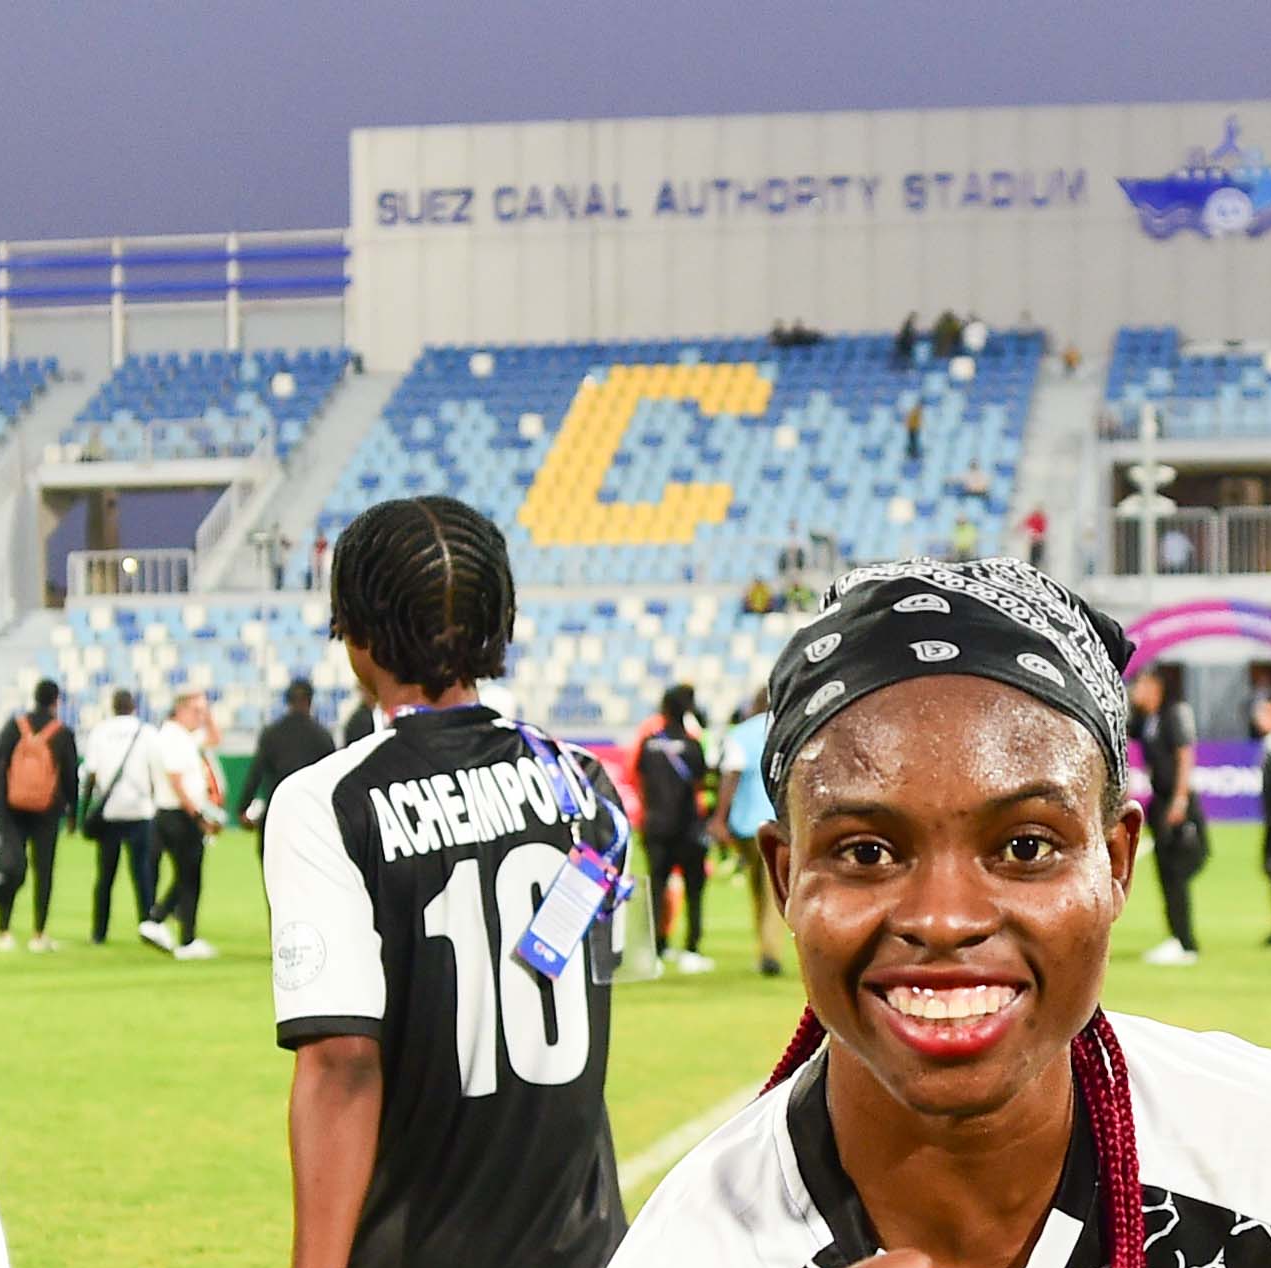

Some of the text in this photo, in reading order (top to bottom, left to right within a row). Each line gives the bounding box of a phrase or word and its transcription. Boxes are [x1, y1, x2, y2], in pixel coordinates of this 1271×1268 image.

[377, 167, 1091, 226] SUEZ CANAL AUTHORITY STADIUM
[424, 843, 591, 1097] 10
